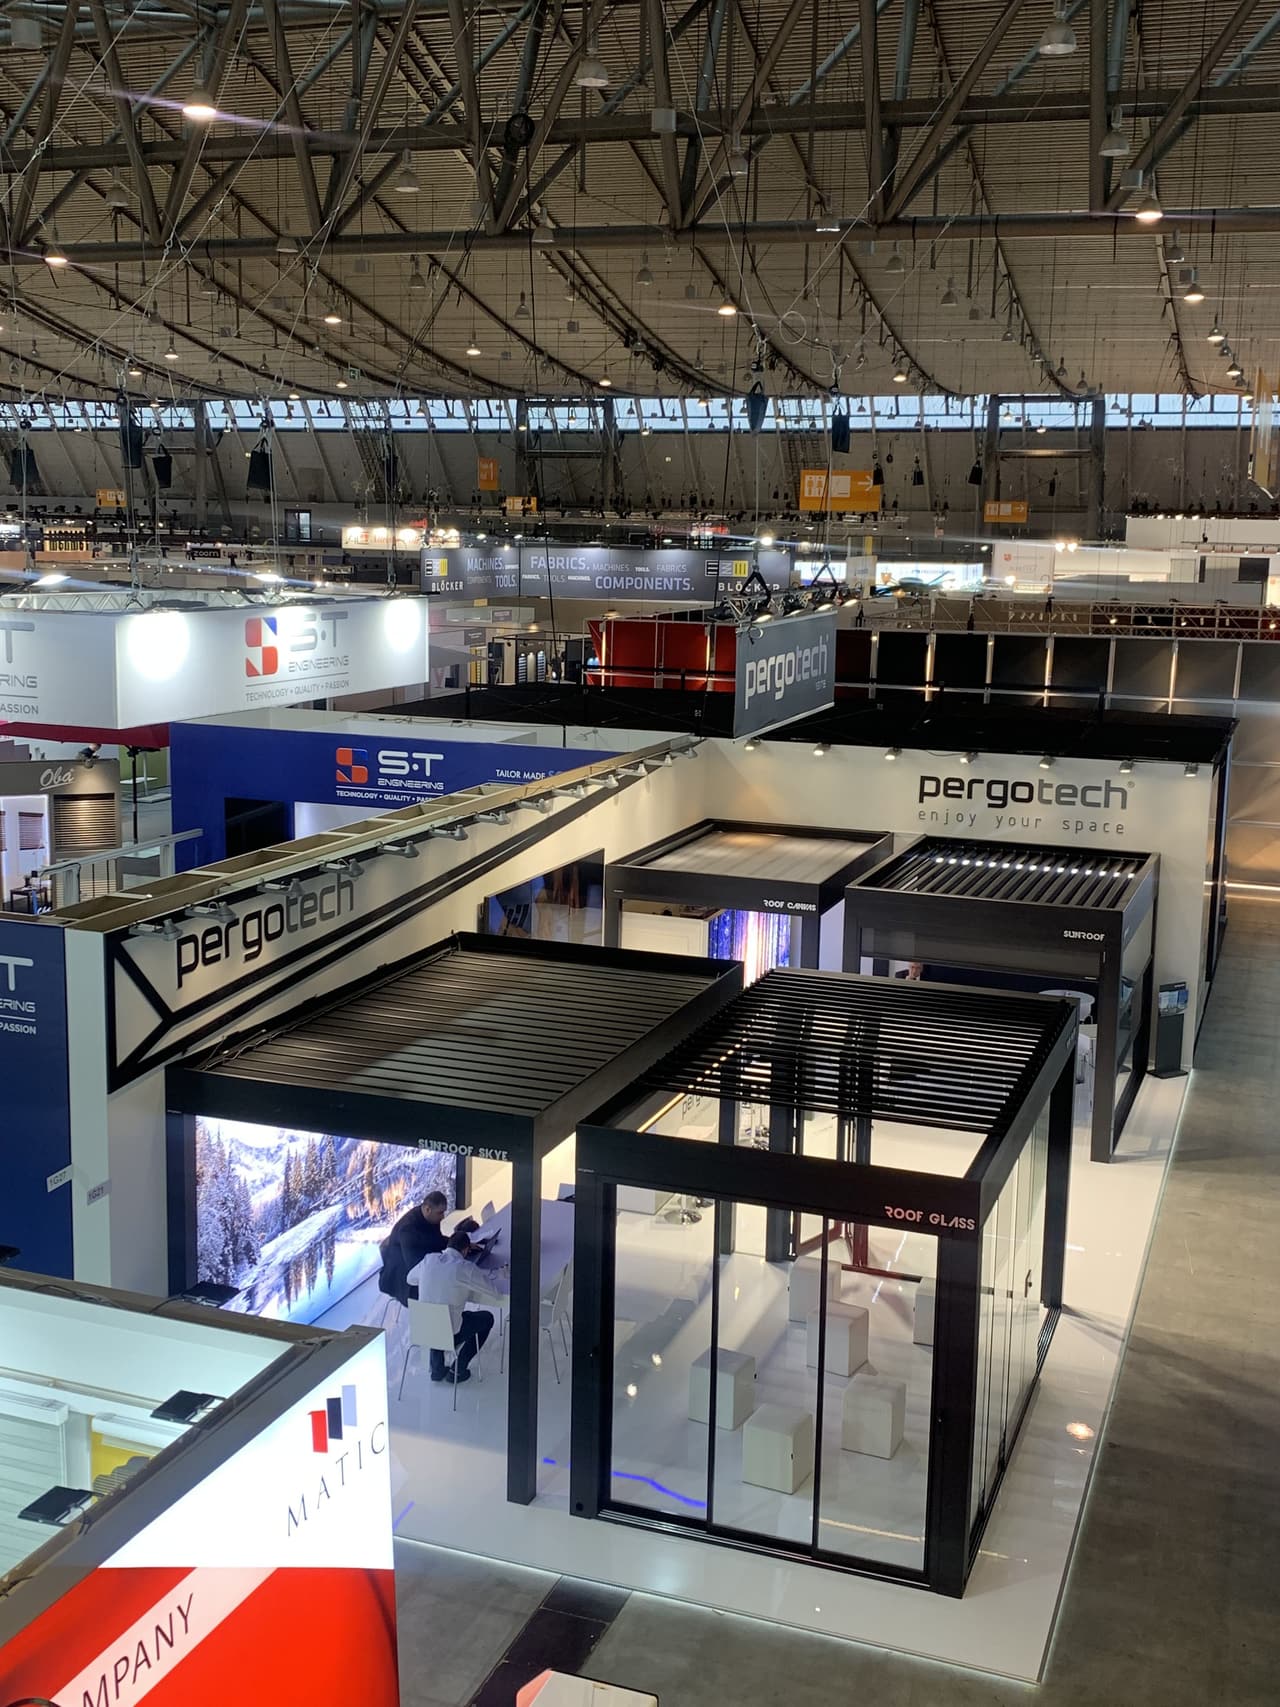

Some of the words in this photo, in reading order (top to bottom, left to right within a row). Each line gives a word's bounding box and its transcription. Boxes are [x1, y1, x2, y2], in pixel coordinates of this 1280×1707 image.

[467, 557, 505, 571] MACHINES.
[530, 556, 590, 570] FABRICS.
[431, 580, 464, 592] BLÖCKER
[495, 575, 518, 588] TOOLS.
[595, 576, 695, 591] COMPONENTS.
[288, 655, 349, 673] ENGINEERING
[246, 688, 289, 702] TECHNOLOGY
[294, 683, 320, 695] QUALITY
[325, 679, 349, 690] PASSION
[40, 766, 74, 790] Oba
[496, 769, 521, 779] TAILOR
[523, 771, 546, 781] MADE
[377, 777, 444, 790] ENGINEERING
[336, 790, 378, 799] TECHNOLOGY
[384, 794, 411, 802] QUALITY
[918, 809, 977, 827] enjoy
[996, 814, 1042, 829] your
[1062, 819, 1125, 835] space
[763, 899, 785, 909] ROOF
[787, 901, 817, 912] CANVAS
[176, 872, 354, 990] pergotech
[1063, 930, 1105, 942] SUNROOF
[418, 1138, 474, 1156] SUNROOF
[478, 1147, 508, 1161] SKYE
[884, 1205, 924, 1223] ROOF
[928, 1212, 976, 1231] GLASS
[287, 1421, 386, 1537] MATIC
